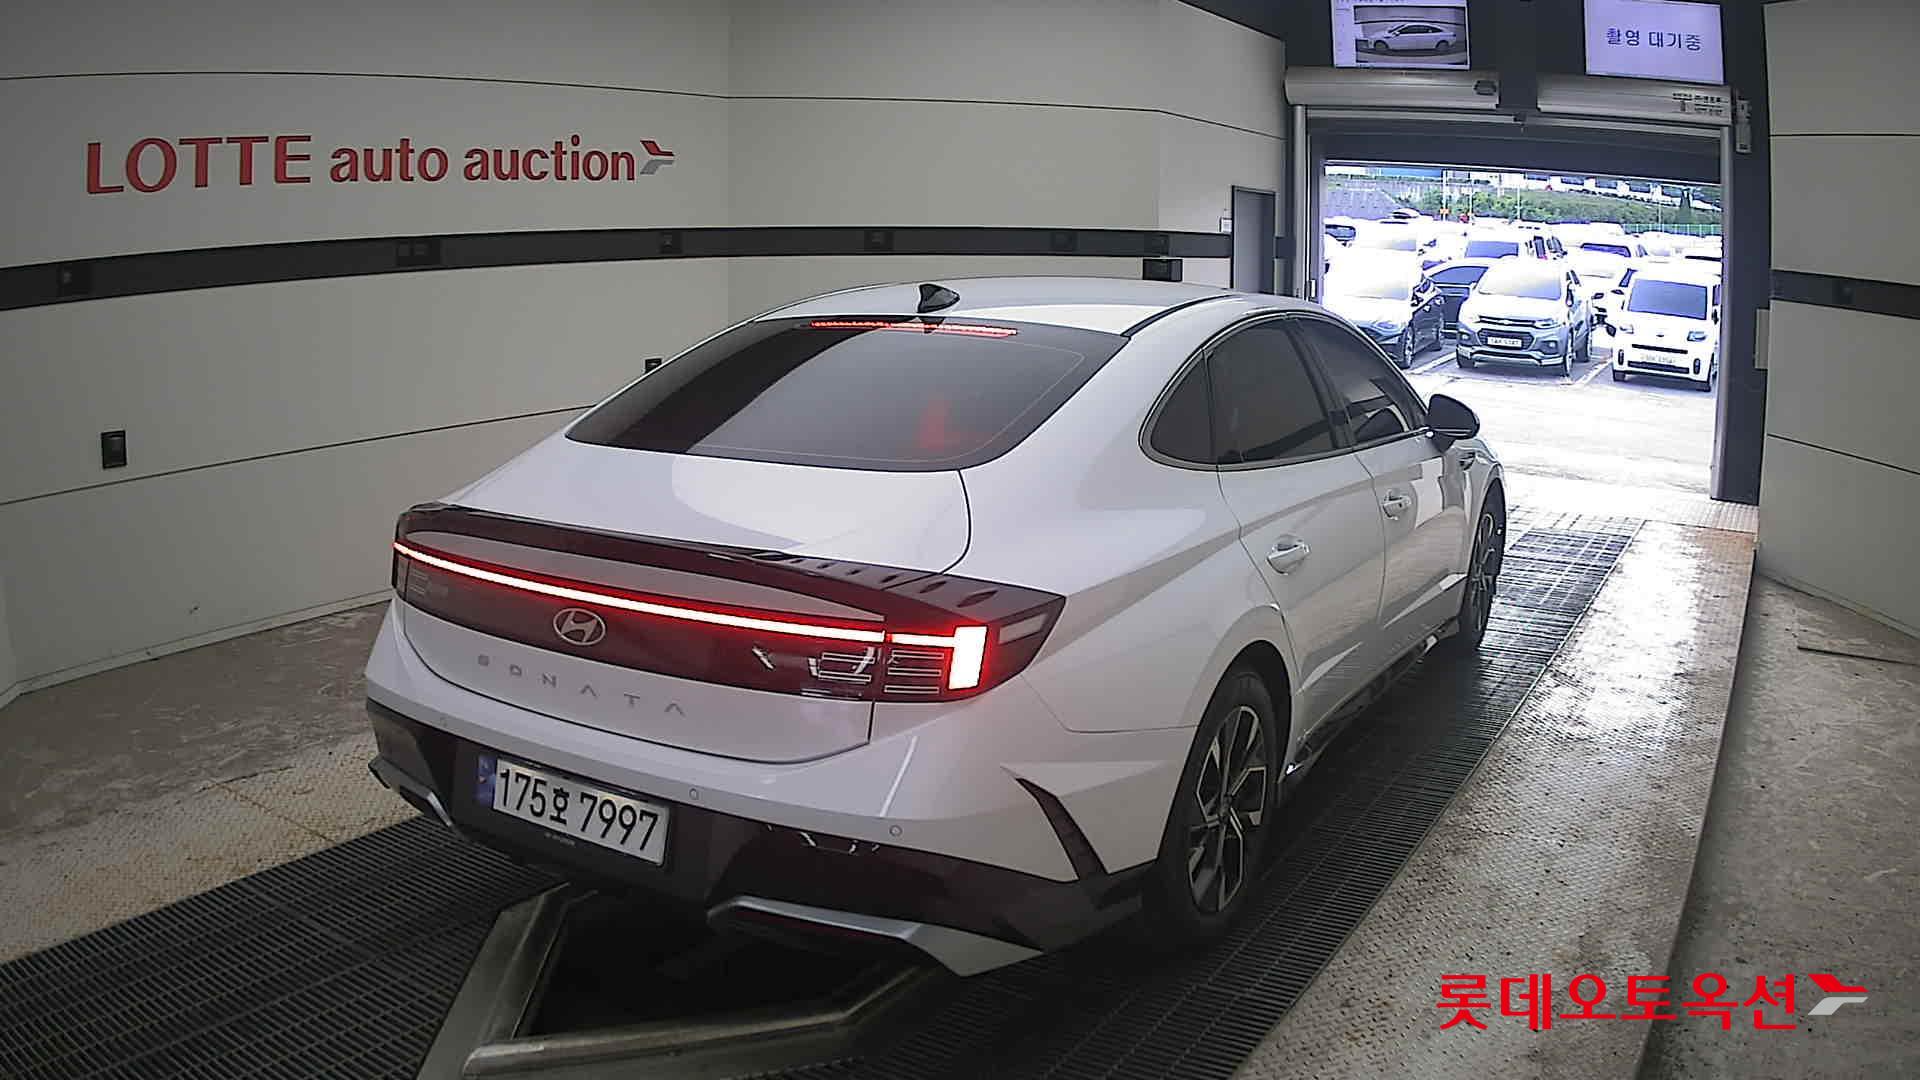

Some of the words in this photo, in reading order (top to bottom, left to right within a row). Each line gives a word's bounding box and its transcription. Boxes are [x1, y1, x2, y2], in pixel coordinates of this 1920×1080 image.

[1648, 31, 1702, 51] 대기중
[86, 135, 311, 194] LOTTE
[329, 137, 448, 184] auto
[464, 134, 635, 183] auction
[477, 654, 685, 715] SONATA
[499, 769, 570, 826] 175호
[580, 793, 659, 850] 7997
